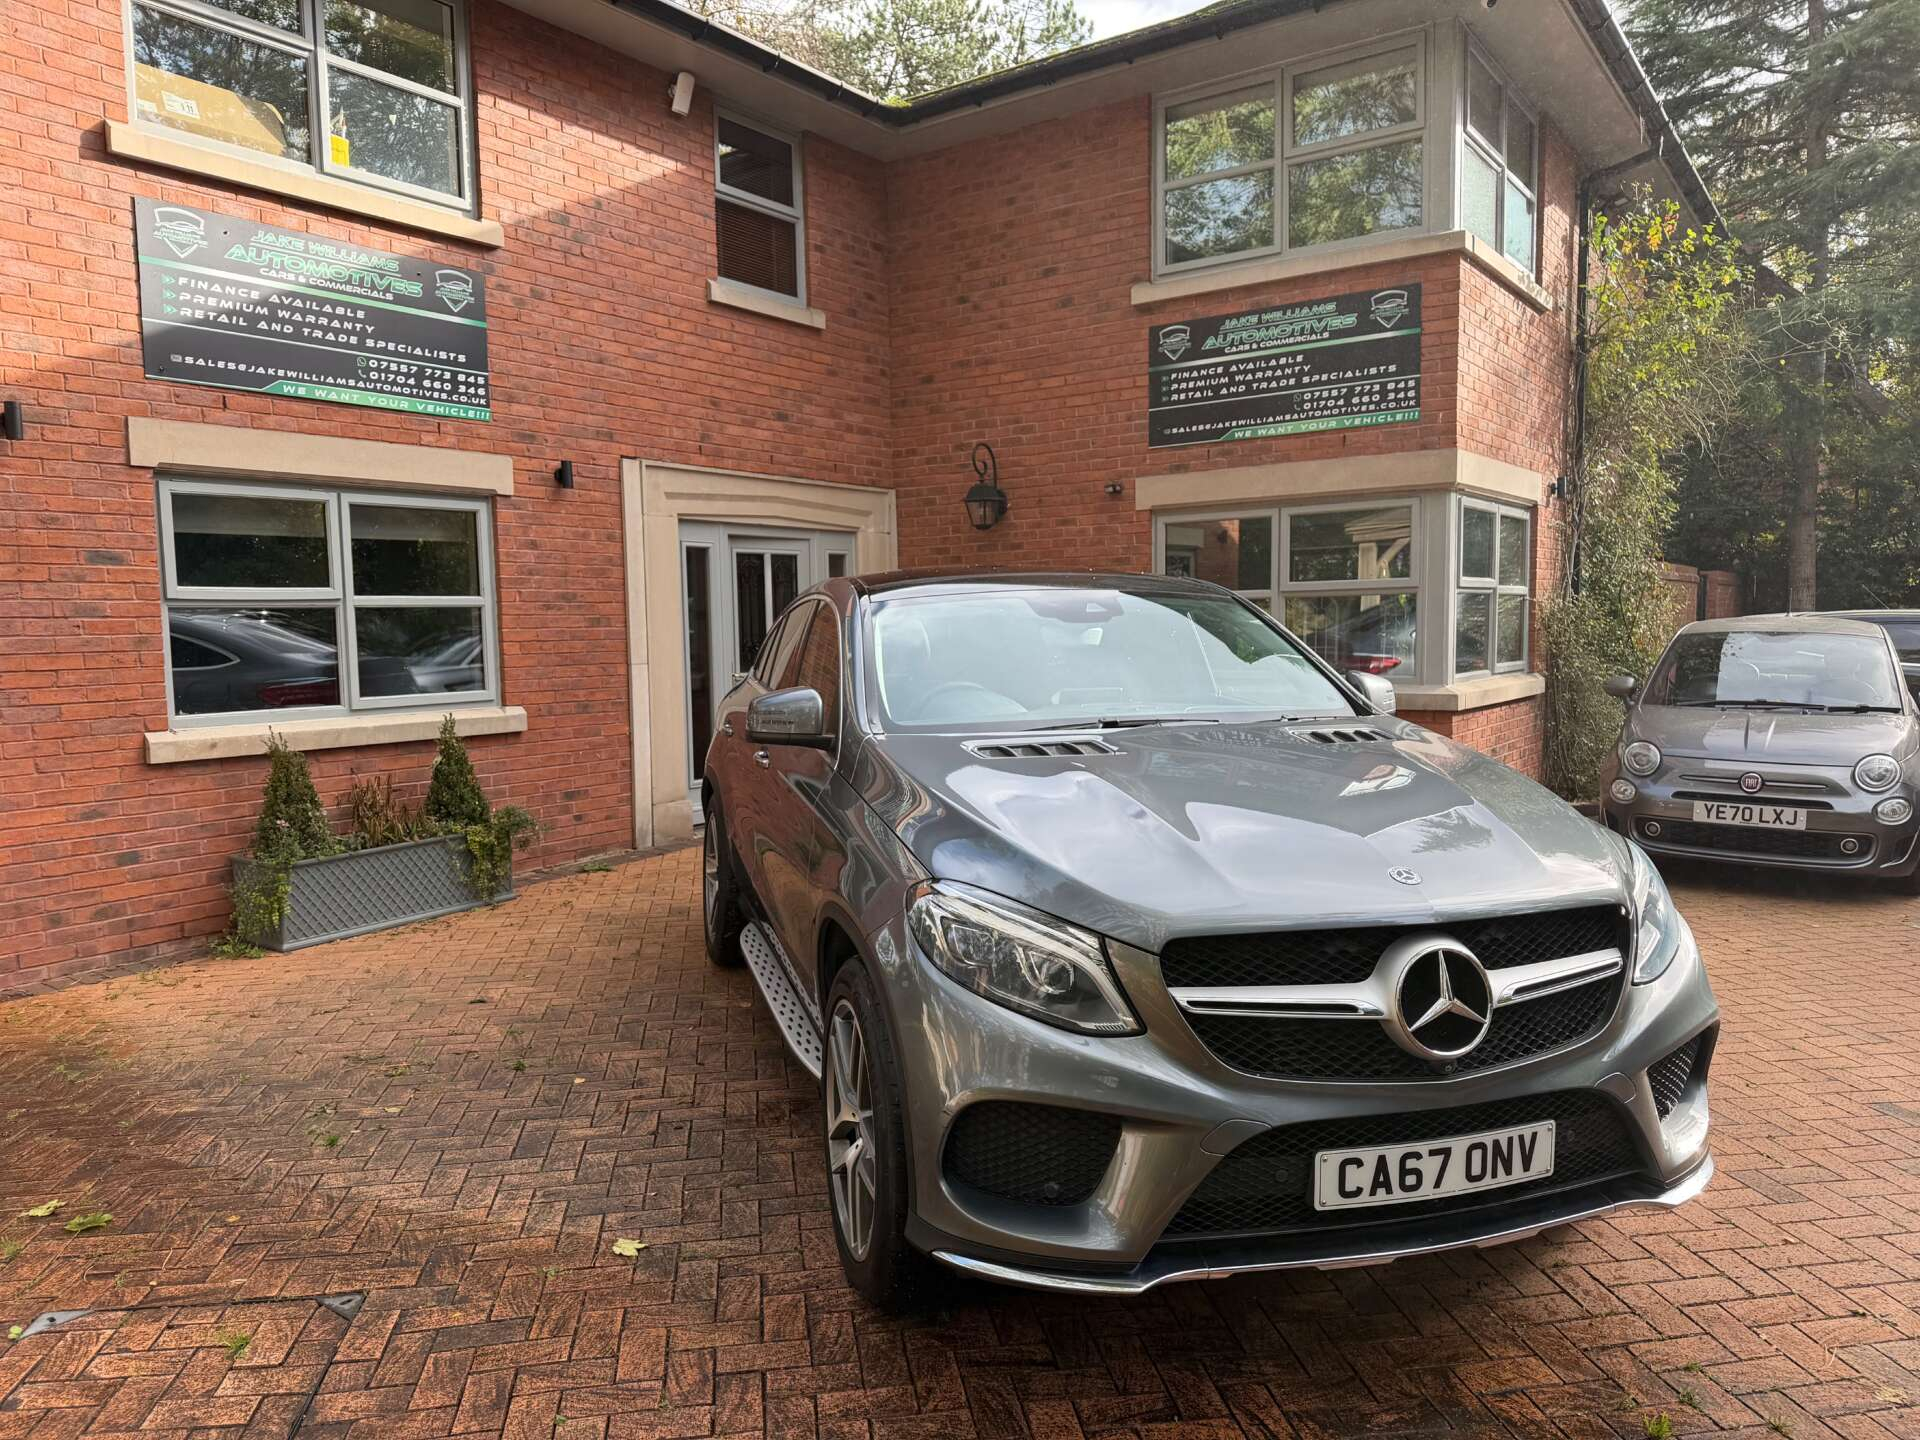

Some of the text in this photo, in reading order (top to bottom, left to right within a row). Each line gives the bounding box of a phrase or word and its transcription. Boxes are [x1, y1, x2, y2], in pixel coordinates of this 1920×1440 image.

[251, 230, 400, 272] JAKE WILLIAMS
[224, 243, 423, 298] AUTOMOTIVES
[259, 268, 394, 301] CARS & COMMERCIALS
[178, 277, 367, 319] FINANCE AVAILABLE
[179, 292, 376, 334] PREMIUM WARRANTY
[1201, 313, 1359, 350] AUTOMOTIVES
[1219, 301, 1337, 330] JAKE WILLIAMS
[180, 307, 467, 363] RETAIL AND TRADE SPECIALISTS
[1224, 342, 1250, 354] CARS
[1260, 331, 1330, 348] COMMERCIALS
[184, 356, 488, 405] SALES@JAKEWILLIAMSAUTOMOTIVES.CO.UK
[369, 359, 486, 385] 07557 773 845
[369, 371, 486, 396] 01704 660 346
[1170, 354, 1305, 381] FINANCE AVAILABLE
[1170, 364, 1311, 391] PREMIUM WARRANTY
[1170, 364, 1397, 401] RETAIL AND TRADE SPECIALISTS
[283, 384, 490, 420] WE WANT YOUR VEHICLE!!!
[1303, 379, 1416, 400] 07557 773 845
[1303, 389, 1416, 410] 01704 660 346
[1171, 399, 1417, 434] SALES@JAKEWILLIAMSAUTOMOTIVES.CO.UK
[1234, 411, 1419, 439] WE WANT YOUR VEHICLE!!!
[1745, 778, 1758, 788] FIAT
[1704, 803, 1798, 826] YE70 LXJ
[1338, 1132, 1538, 1199] CA67 ONV
